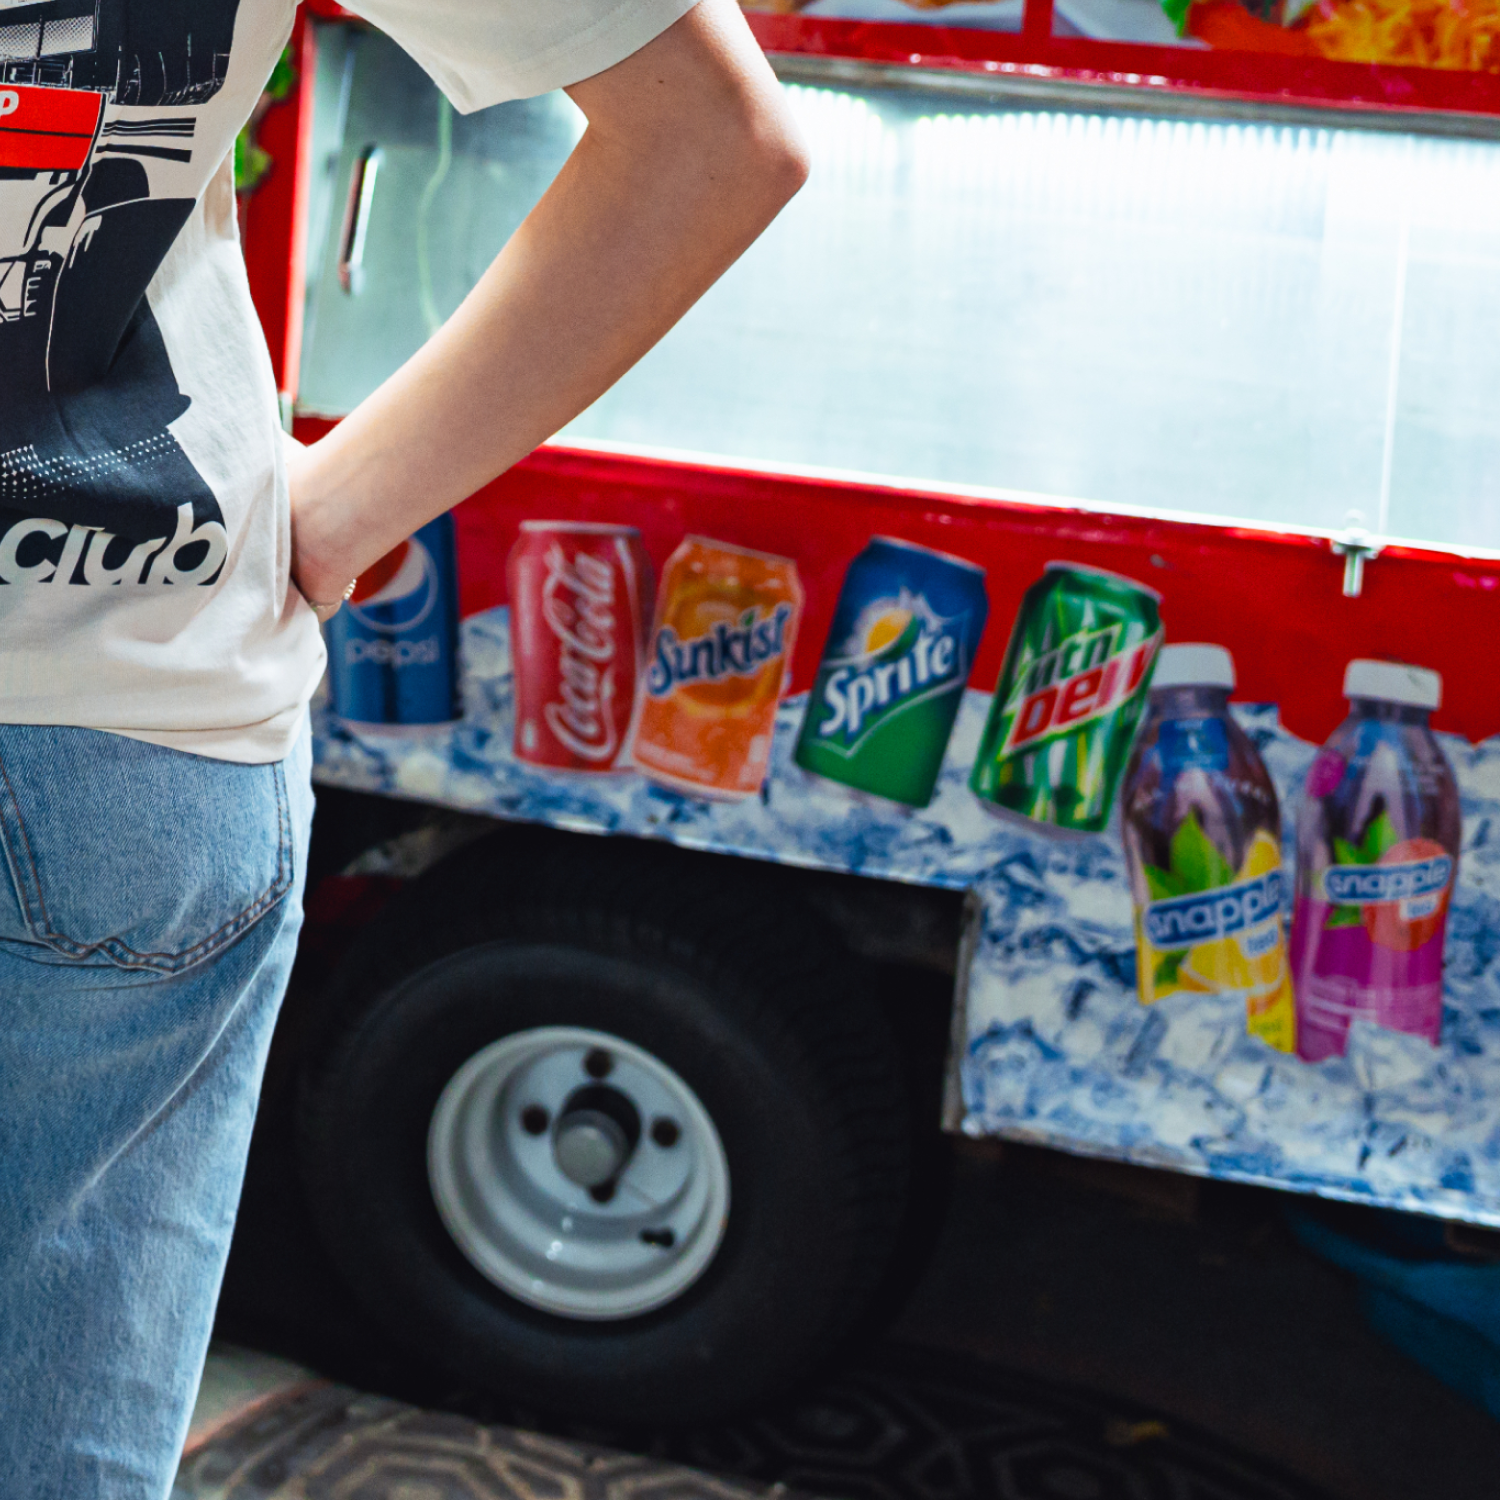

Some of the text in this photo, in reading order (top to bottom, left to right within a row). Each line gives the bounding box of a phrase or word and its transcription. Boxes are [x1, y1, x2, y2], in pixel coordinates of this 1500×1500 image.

[345, 636, 440, 668] pepsi
[649, 602, 792, 697] Sunkist
[819, 630, 954, 740] Sprite
